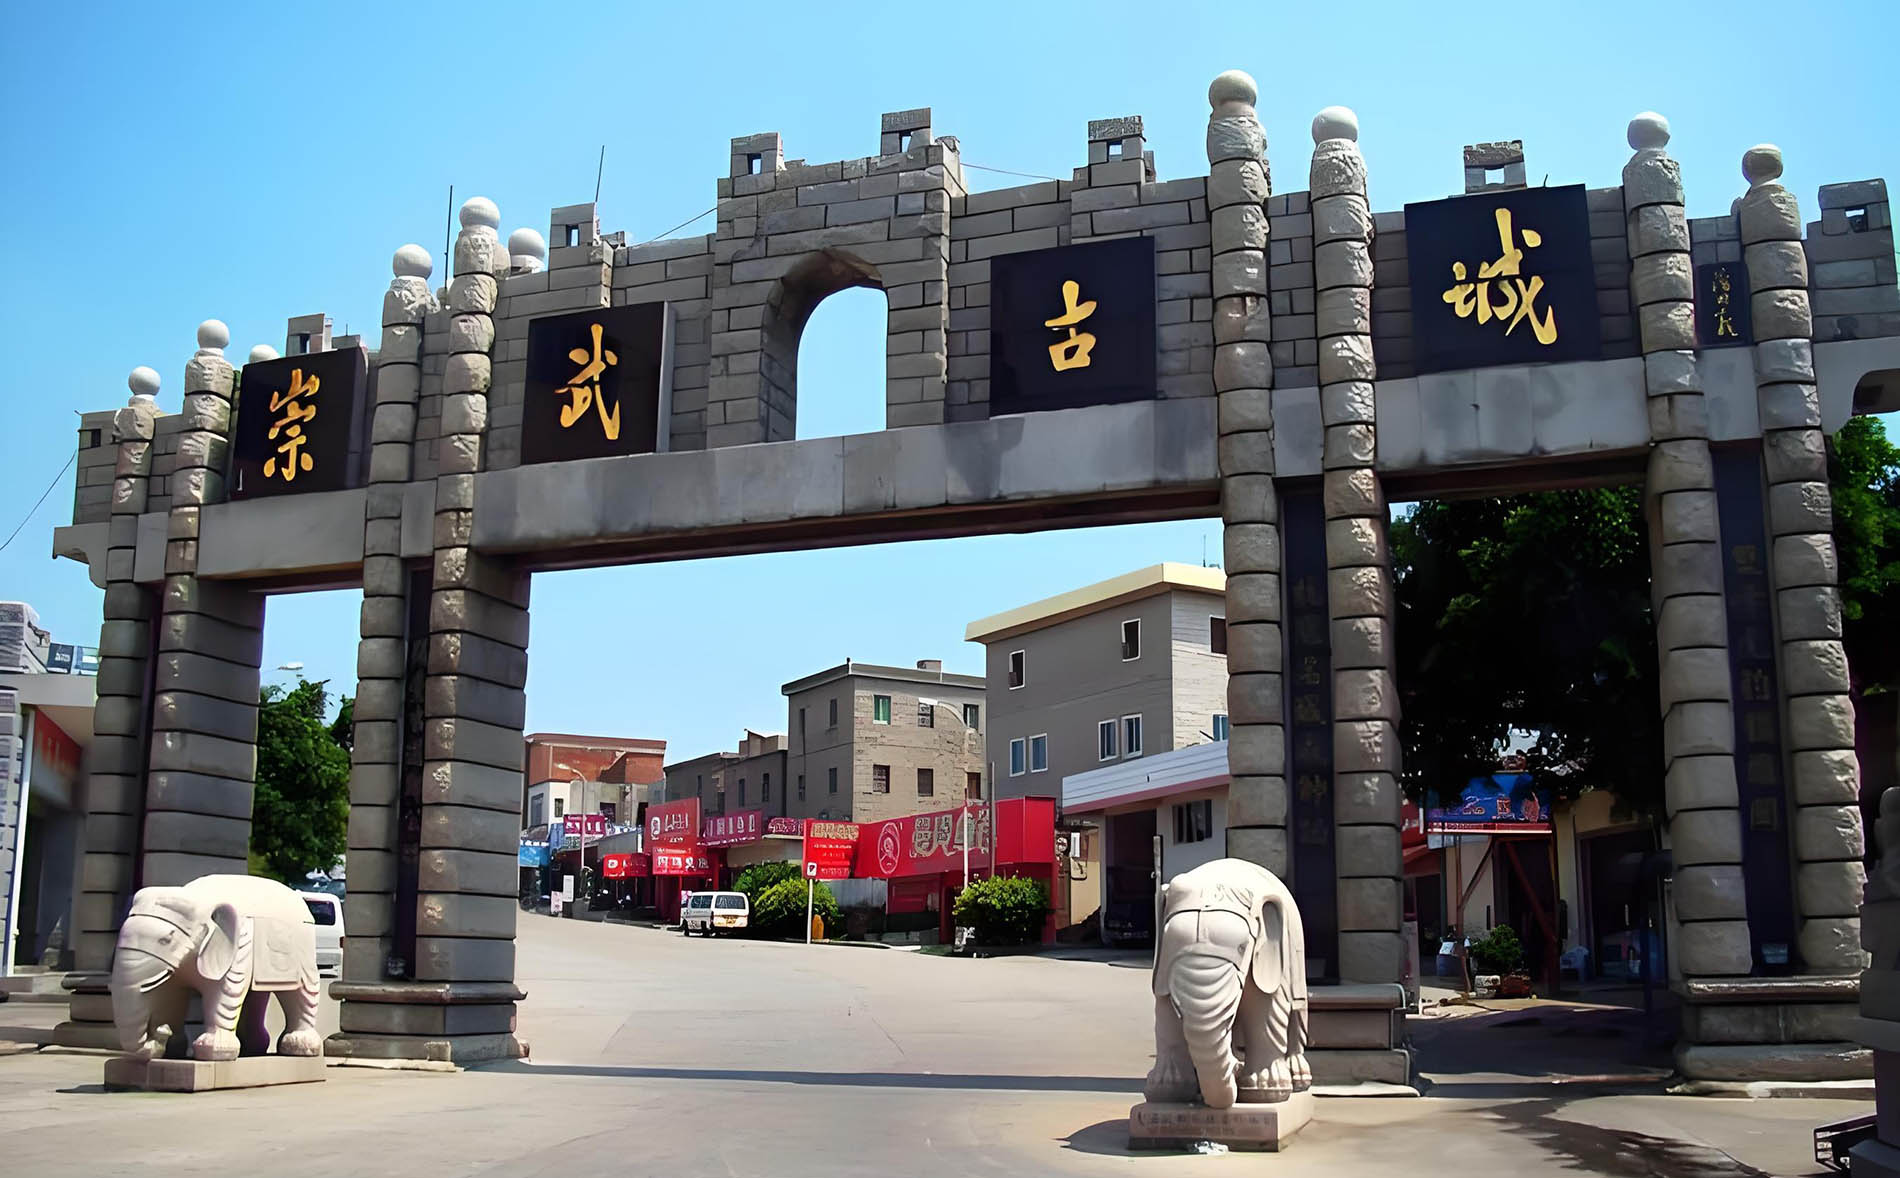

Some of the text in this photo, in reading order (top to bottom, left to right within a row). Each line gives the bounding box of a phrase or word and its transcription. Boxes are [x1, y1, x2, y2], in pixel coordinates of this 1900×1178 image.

[263, 368, 320, 482] 崇
[554, 323, 621, 441] 武
[1045, 279, 1098, 372] 古
